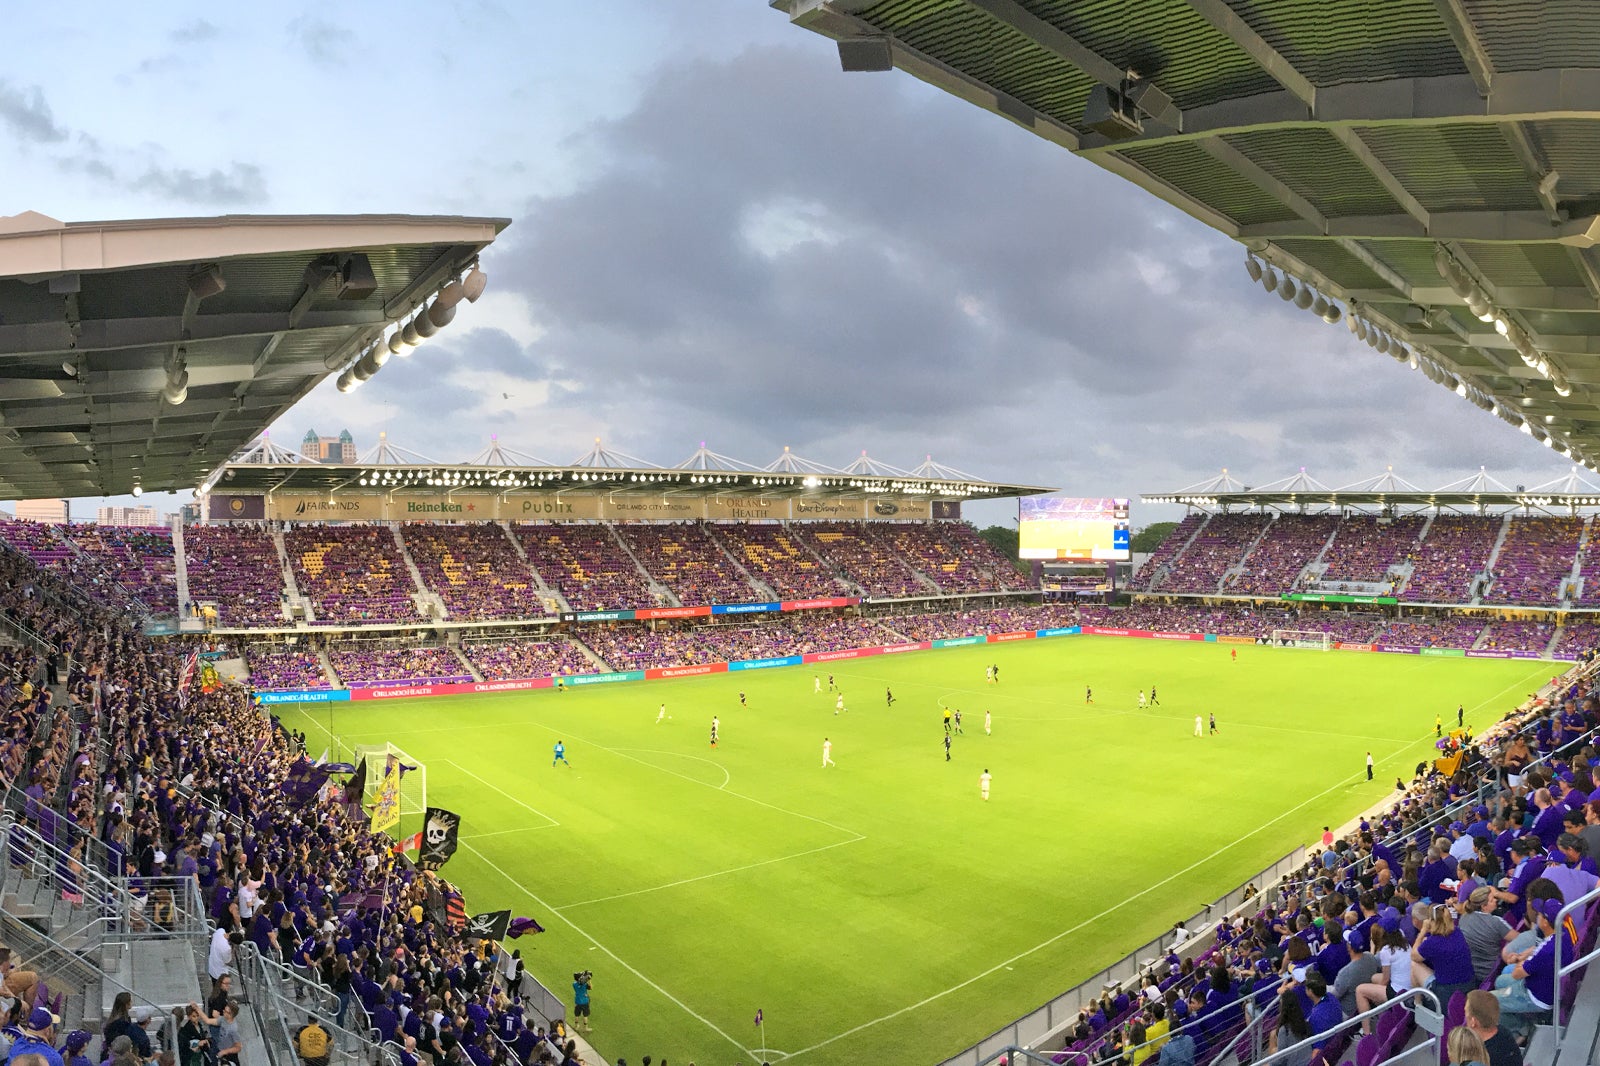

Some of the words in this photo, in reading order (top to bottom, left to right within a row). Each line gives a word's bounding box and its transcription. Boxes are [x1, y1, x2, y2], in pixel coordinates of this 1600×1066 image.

[306, 502, 360, 512] FAIRWINDS
[407, 501, 463, 513] Heineken
[522, 501, 573, 513] Publix
[726, 498, 772, 508] ORLANDO
[732, 508, 769, 519] HEALTH
[1307, 939, 1321, 957] 10
